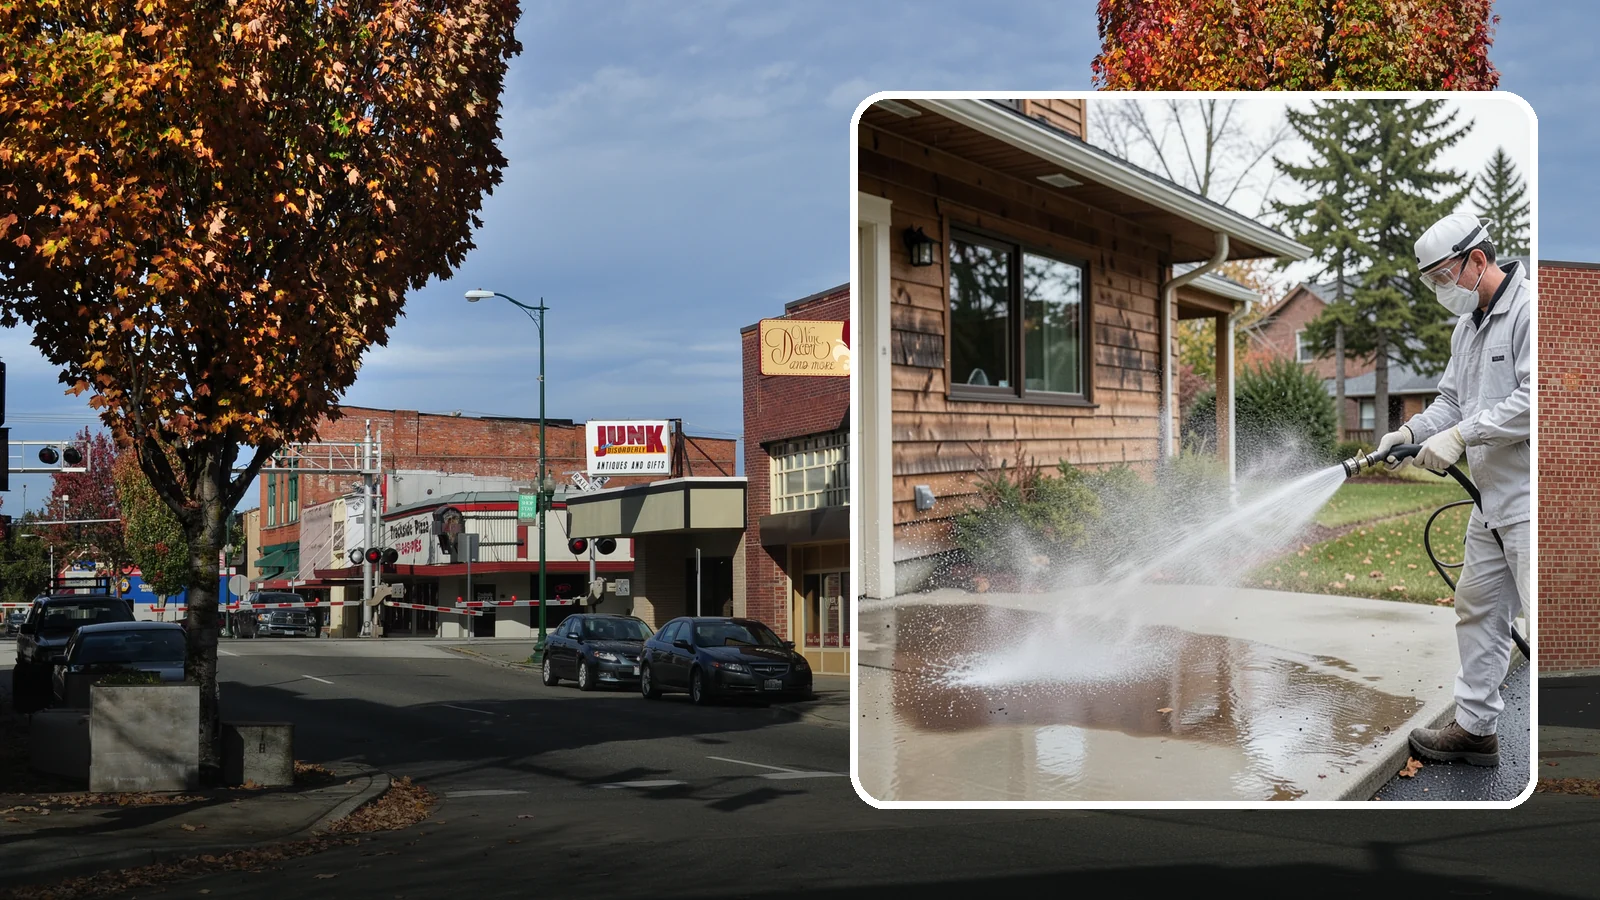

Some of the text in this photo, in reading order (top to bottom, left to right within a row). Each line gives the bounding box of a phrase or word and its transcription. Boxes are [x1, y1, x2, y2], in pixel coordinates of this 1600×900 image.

[765, 327, 831, 365] Decor
[596, 425, 664, 457] JUNK
[607, 446, 646, 454] DISORDERLY
[597, 460, 665, 470] ANTIQUES AND GIFTS
[573, 473, 588, 492] RAIL
[590, 476, 608, 492] SING
[352, 498, 364, 511] CRO
[390, 519, 429, 539] Trackside Pizza
